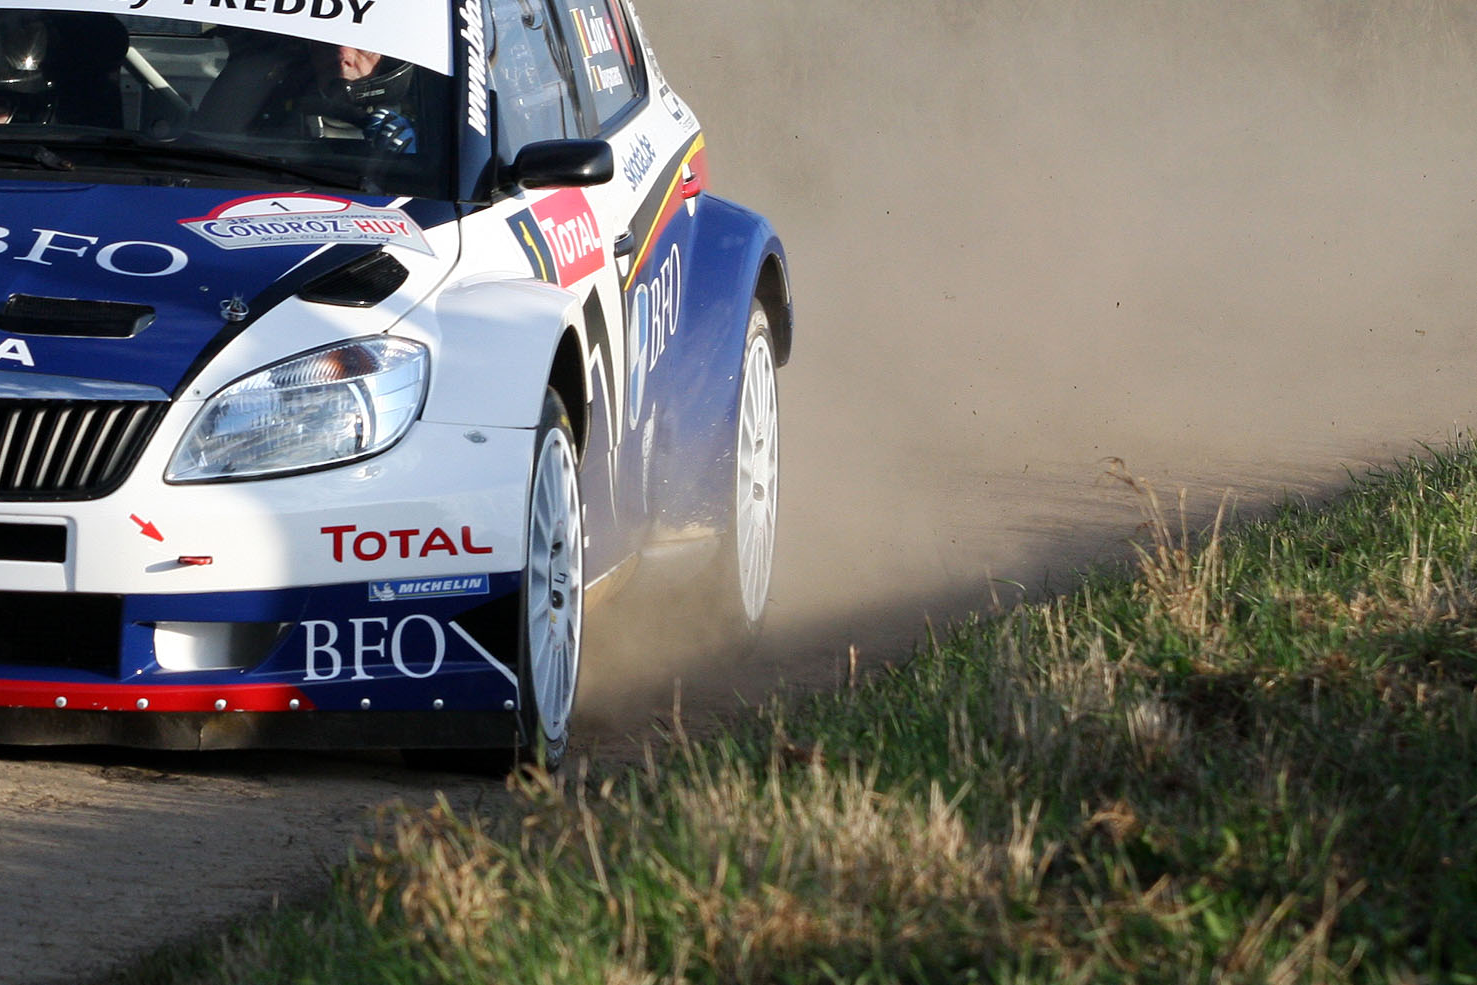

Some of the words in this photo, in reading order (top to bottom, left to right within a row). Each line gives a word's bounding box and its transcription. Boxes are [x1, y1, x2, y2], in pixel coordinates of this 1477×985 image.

[270, 200, 292, 212] 1
[538, 210, 602, 268] TOTAL
[648, 243, 682, 373] BFO
[321, 524, 494, 563] TOTAL
[398, 577, 483, 596] MICHELIN
[301, 613, 447, 682] BFO
